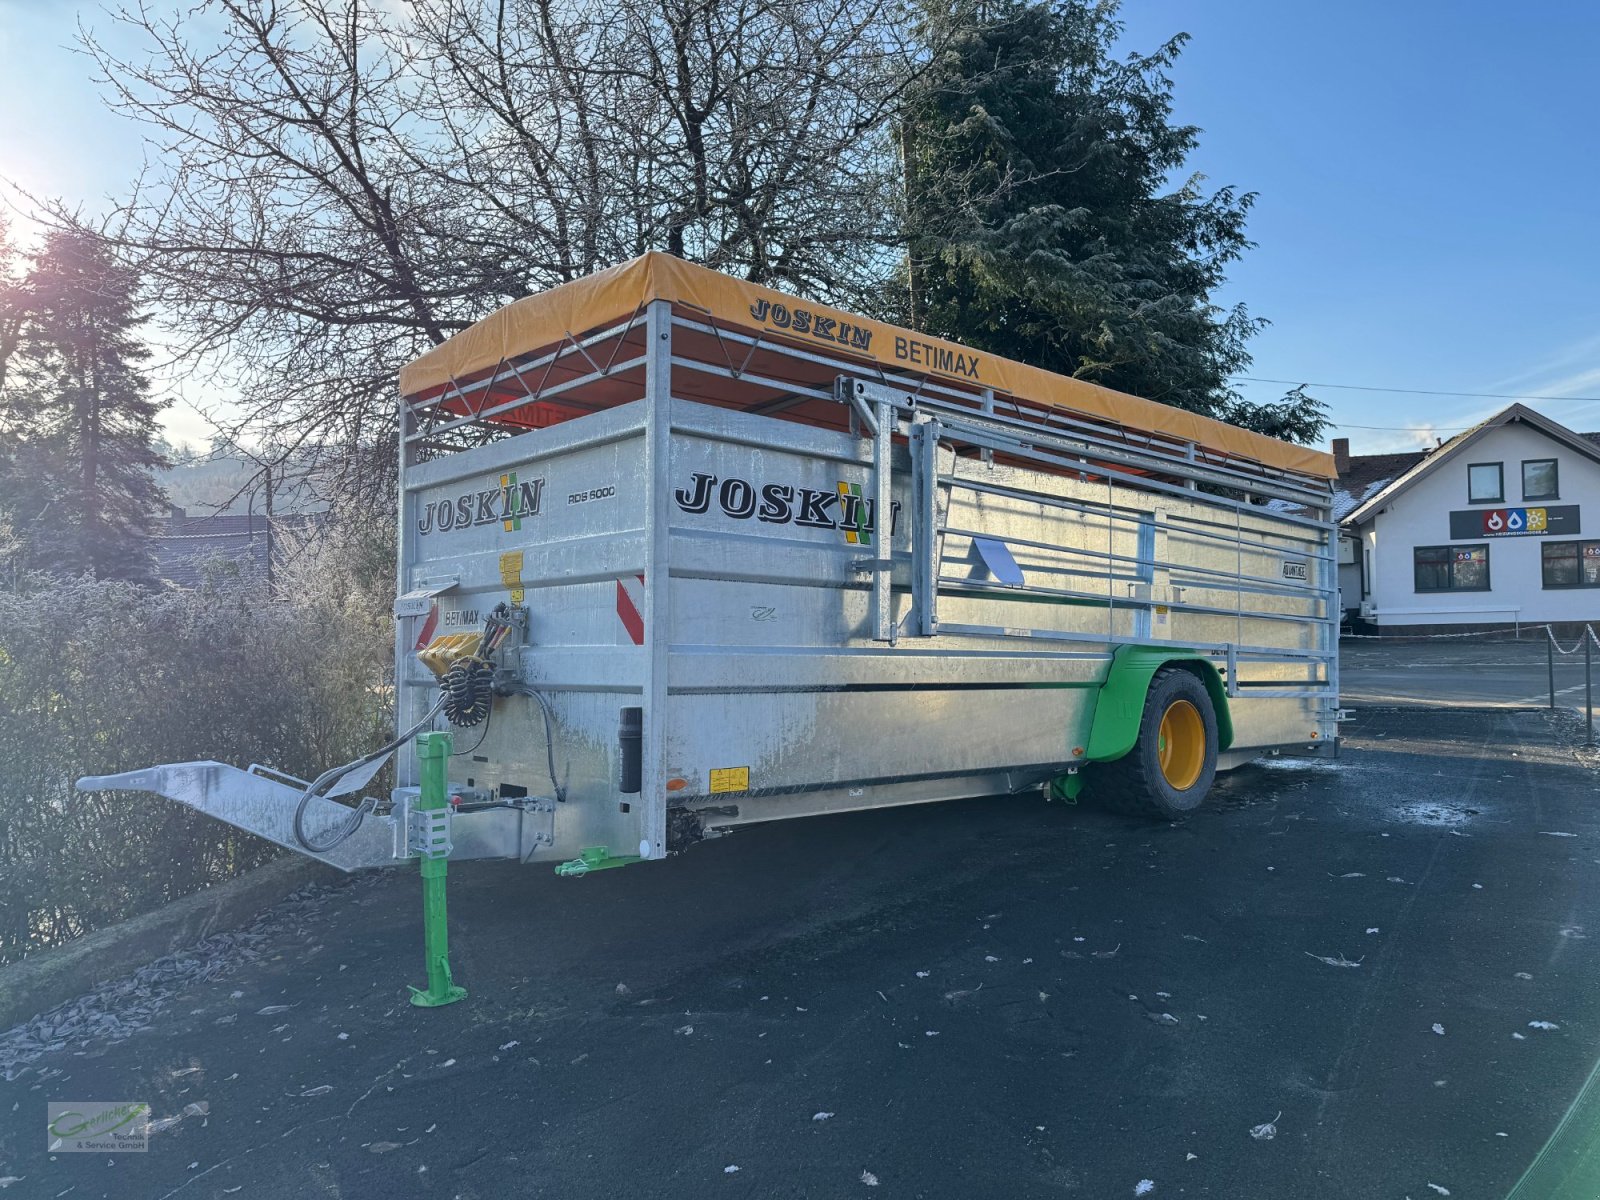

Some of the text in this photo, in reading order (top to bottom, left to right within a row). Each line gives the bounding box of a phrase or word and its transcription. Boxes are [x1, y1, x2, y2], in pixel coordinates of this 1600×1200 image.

[750, 298, 872, 351] JOSKIN
[895, 335, 980, 379] BETIMAX
[418, 477, 545, 535] JOSKIN
[568, 486, 615, 505] RDS 6000
[445, 610, 479, 626] BETIMAX
